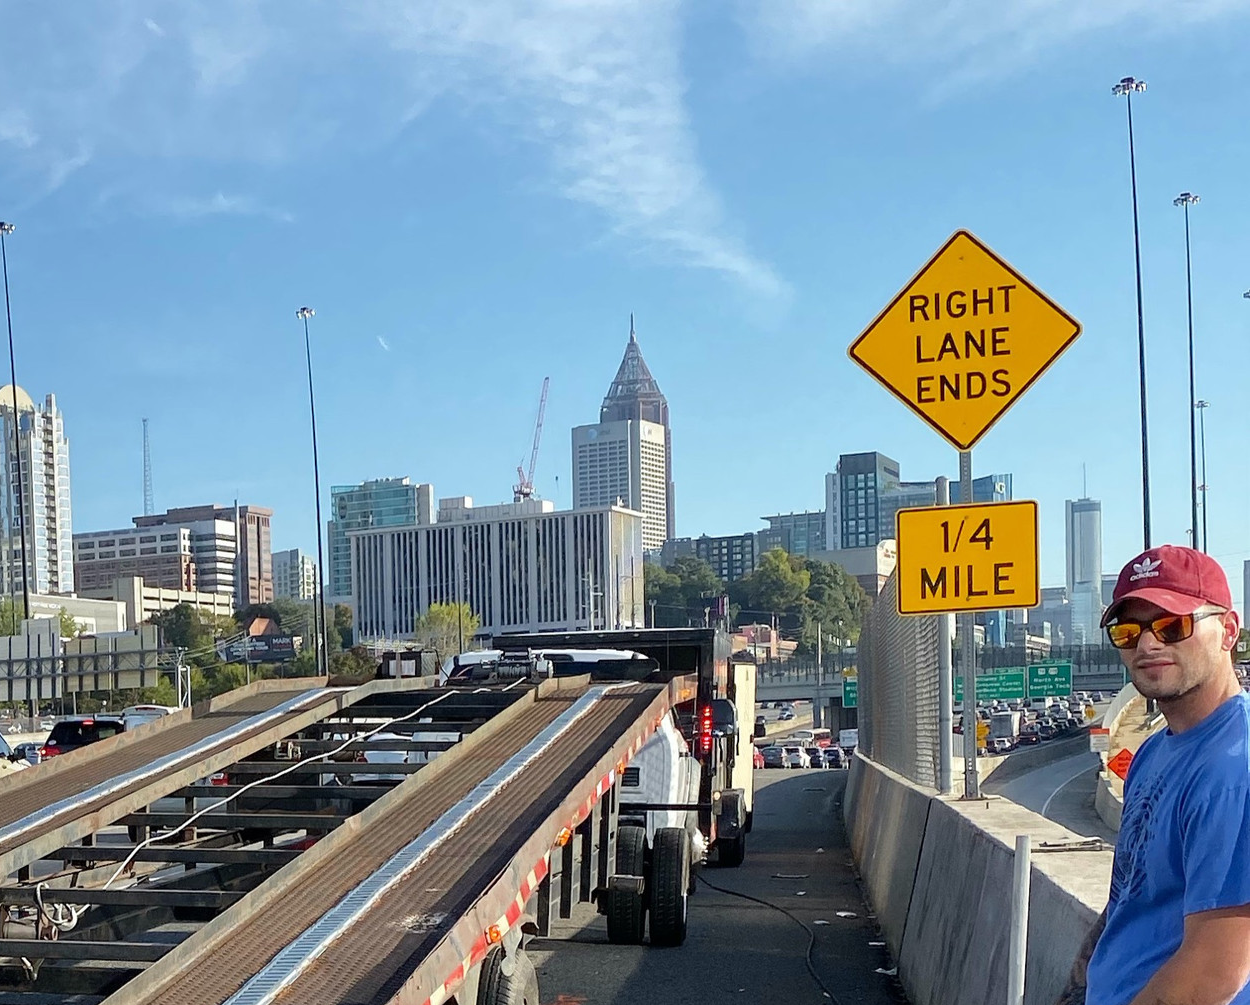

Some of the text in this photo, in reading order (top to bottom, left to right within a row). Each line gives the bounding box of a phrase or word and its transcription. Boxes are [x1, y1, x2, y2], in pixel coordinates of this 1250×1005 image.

[909, 285, 1017, 323] RIGHT
[916, 326, 1011, 364] LANE
[917, 369, 1011, 404] ENDS
[940, 517, 994, 553] 1/4
[920, 562, 1015, 600] MILE
[1130, 571, 1159, 581] adidas
